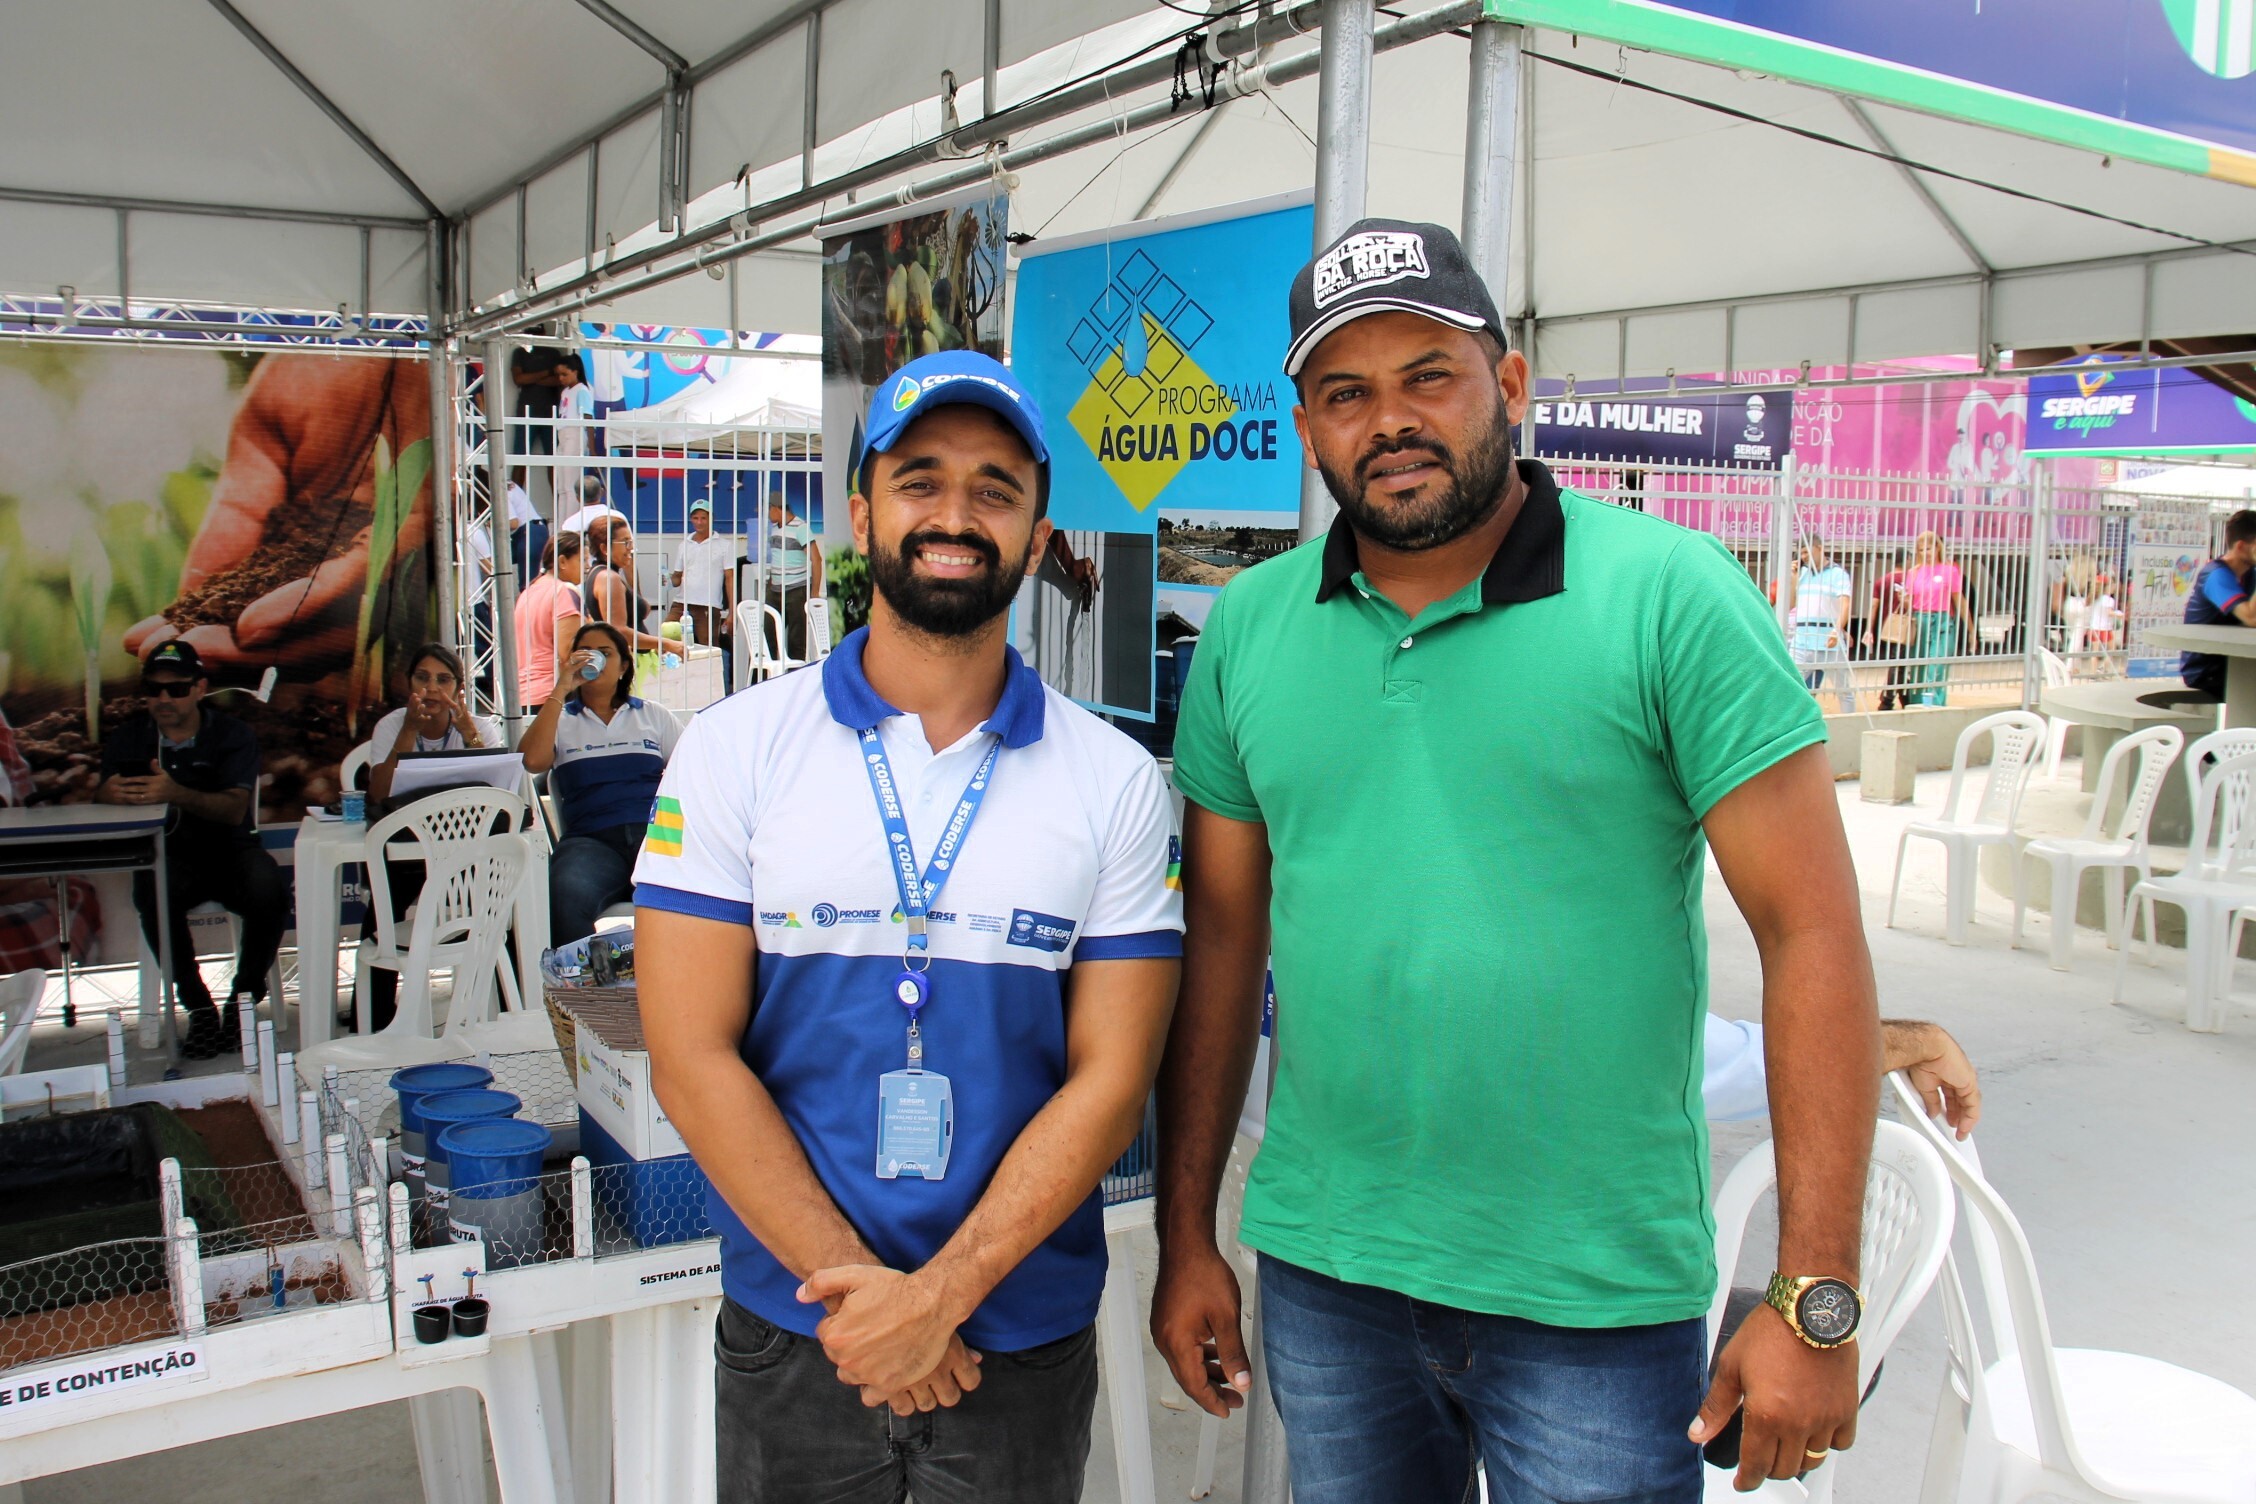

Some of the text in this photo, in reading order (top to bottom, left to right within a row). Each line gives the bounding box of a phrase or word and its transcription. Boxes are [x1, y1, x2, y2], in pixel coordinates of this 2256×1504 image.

[1318, 263, 1345, 291] DA
[1352, 249, 1422, 274] ROÇA
[1357, 268, 1388, 281] HORSE
[1158, 380, 1277, 415] PROGRAMA
[2040, 395, 2137, 418] SERGIPE
[1557, 400, 1595, 428] DA
[1600, 404, 1703, 435] MULHER
[1098, 414, 1277, 462] ÁGUA DOCE
[1810, 427, 1835, 446] DA
[1734, 443, 1772, 457] SERGIPE
[2142, 553, 2174, 568] Inclusão
[874, 762, 901, 820] CODERSE
[938, 800, 973, 859] CODERSE
[897, 843, 922, 908] CODERSE
[839, 909, 881, 918] PRONESE
[1035, 924, 1072, 940] SERGIPE
[640, 1270, 687, 1285] SISTEMA
[689, 1266, 704, 1277] DE
[448, 1295, 464, 1303] ÁGUA
[19, 1381, 51, 1403] DE
[56, 1350, 196, 1393] CONTENÇÃO
